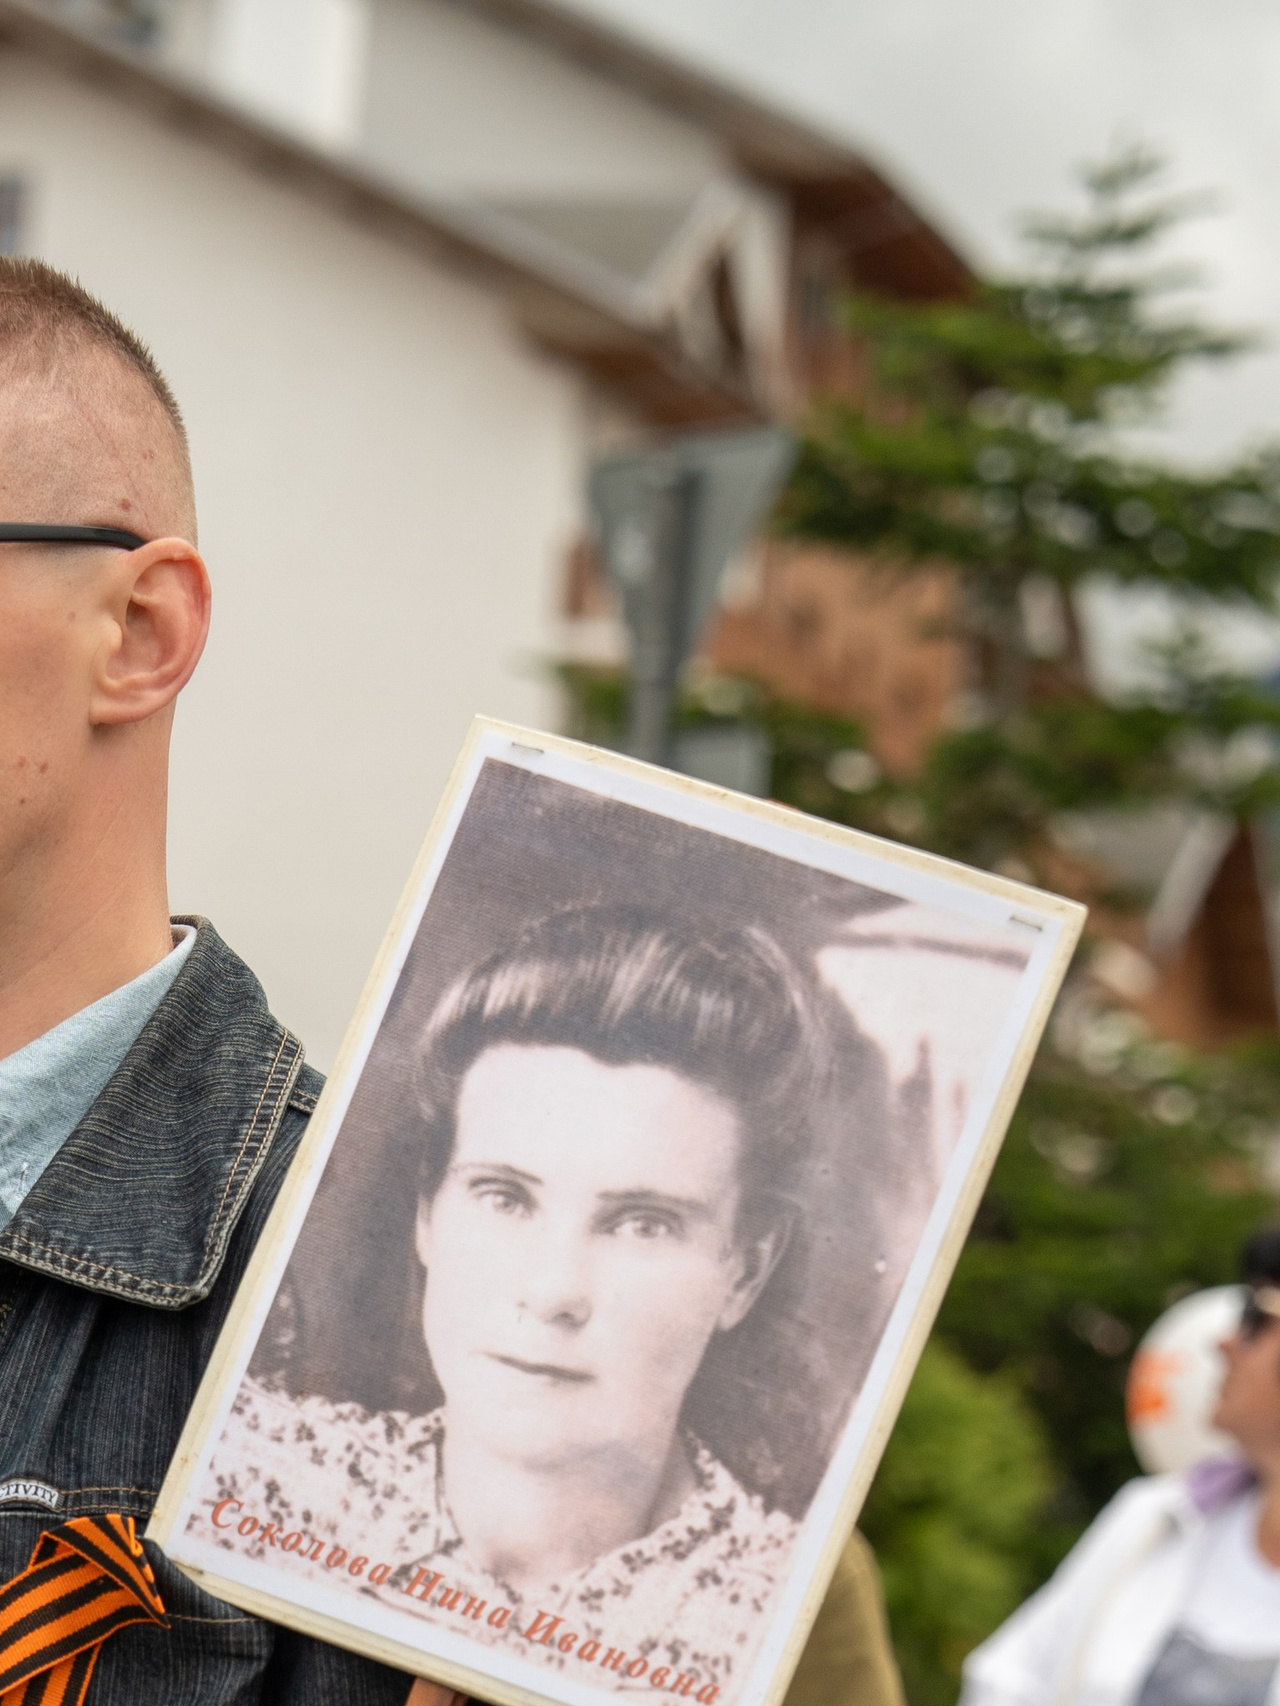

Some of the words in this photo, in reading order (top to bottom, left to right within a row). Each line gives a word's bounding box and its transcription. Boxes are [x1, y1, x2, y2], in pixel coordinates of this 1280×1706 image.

[211, 1496, 390, 1585] Соколова
[402, 1568, 510, 1628] Нина
[523, 1610, 721, 1706] Ивановна
